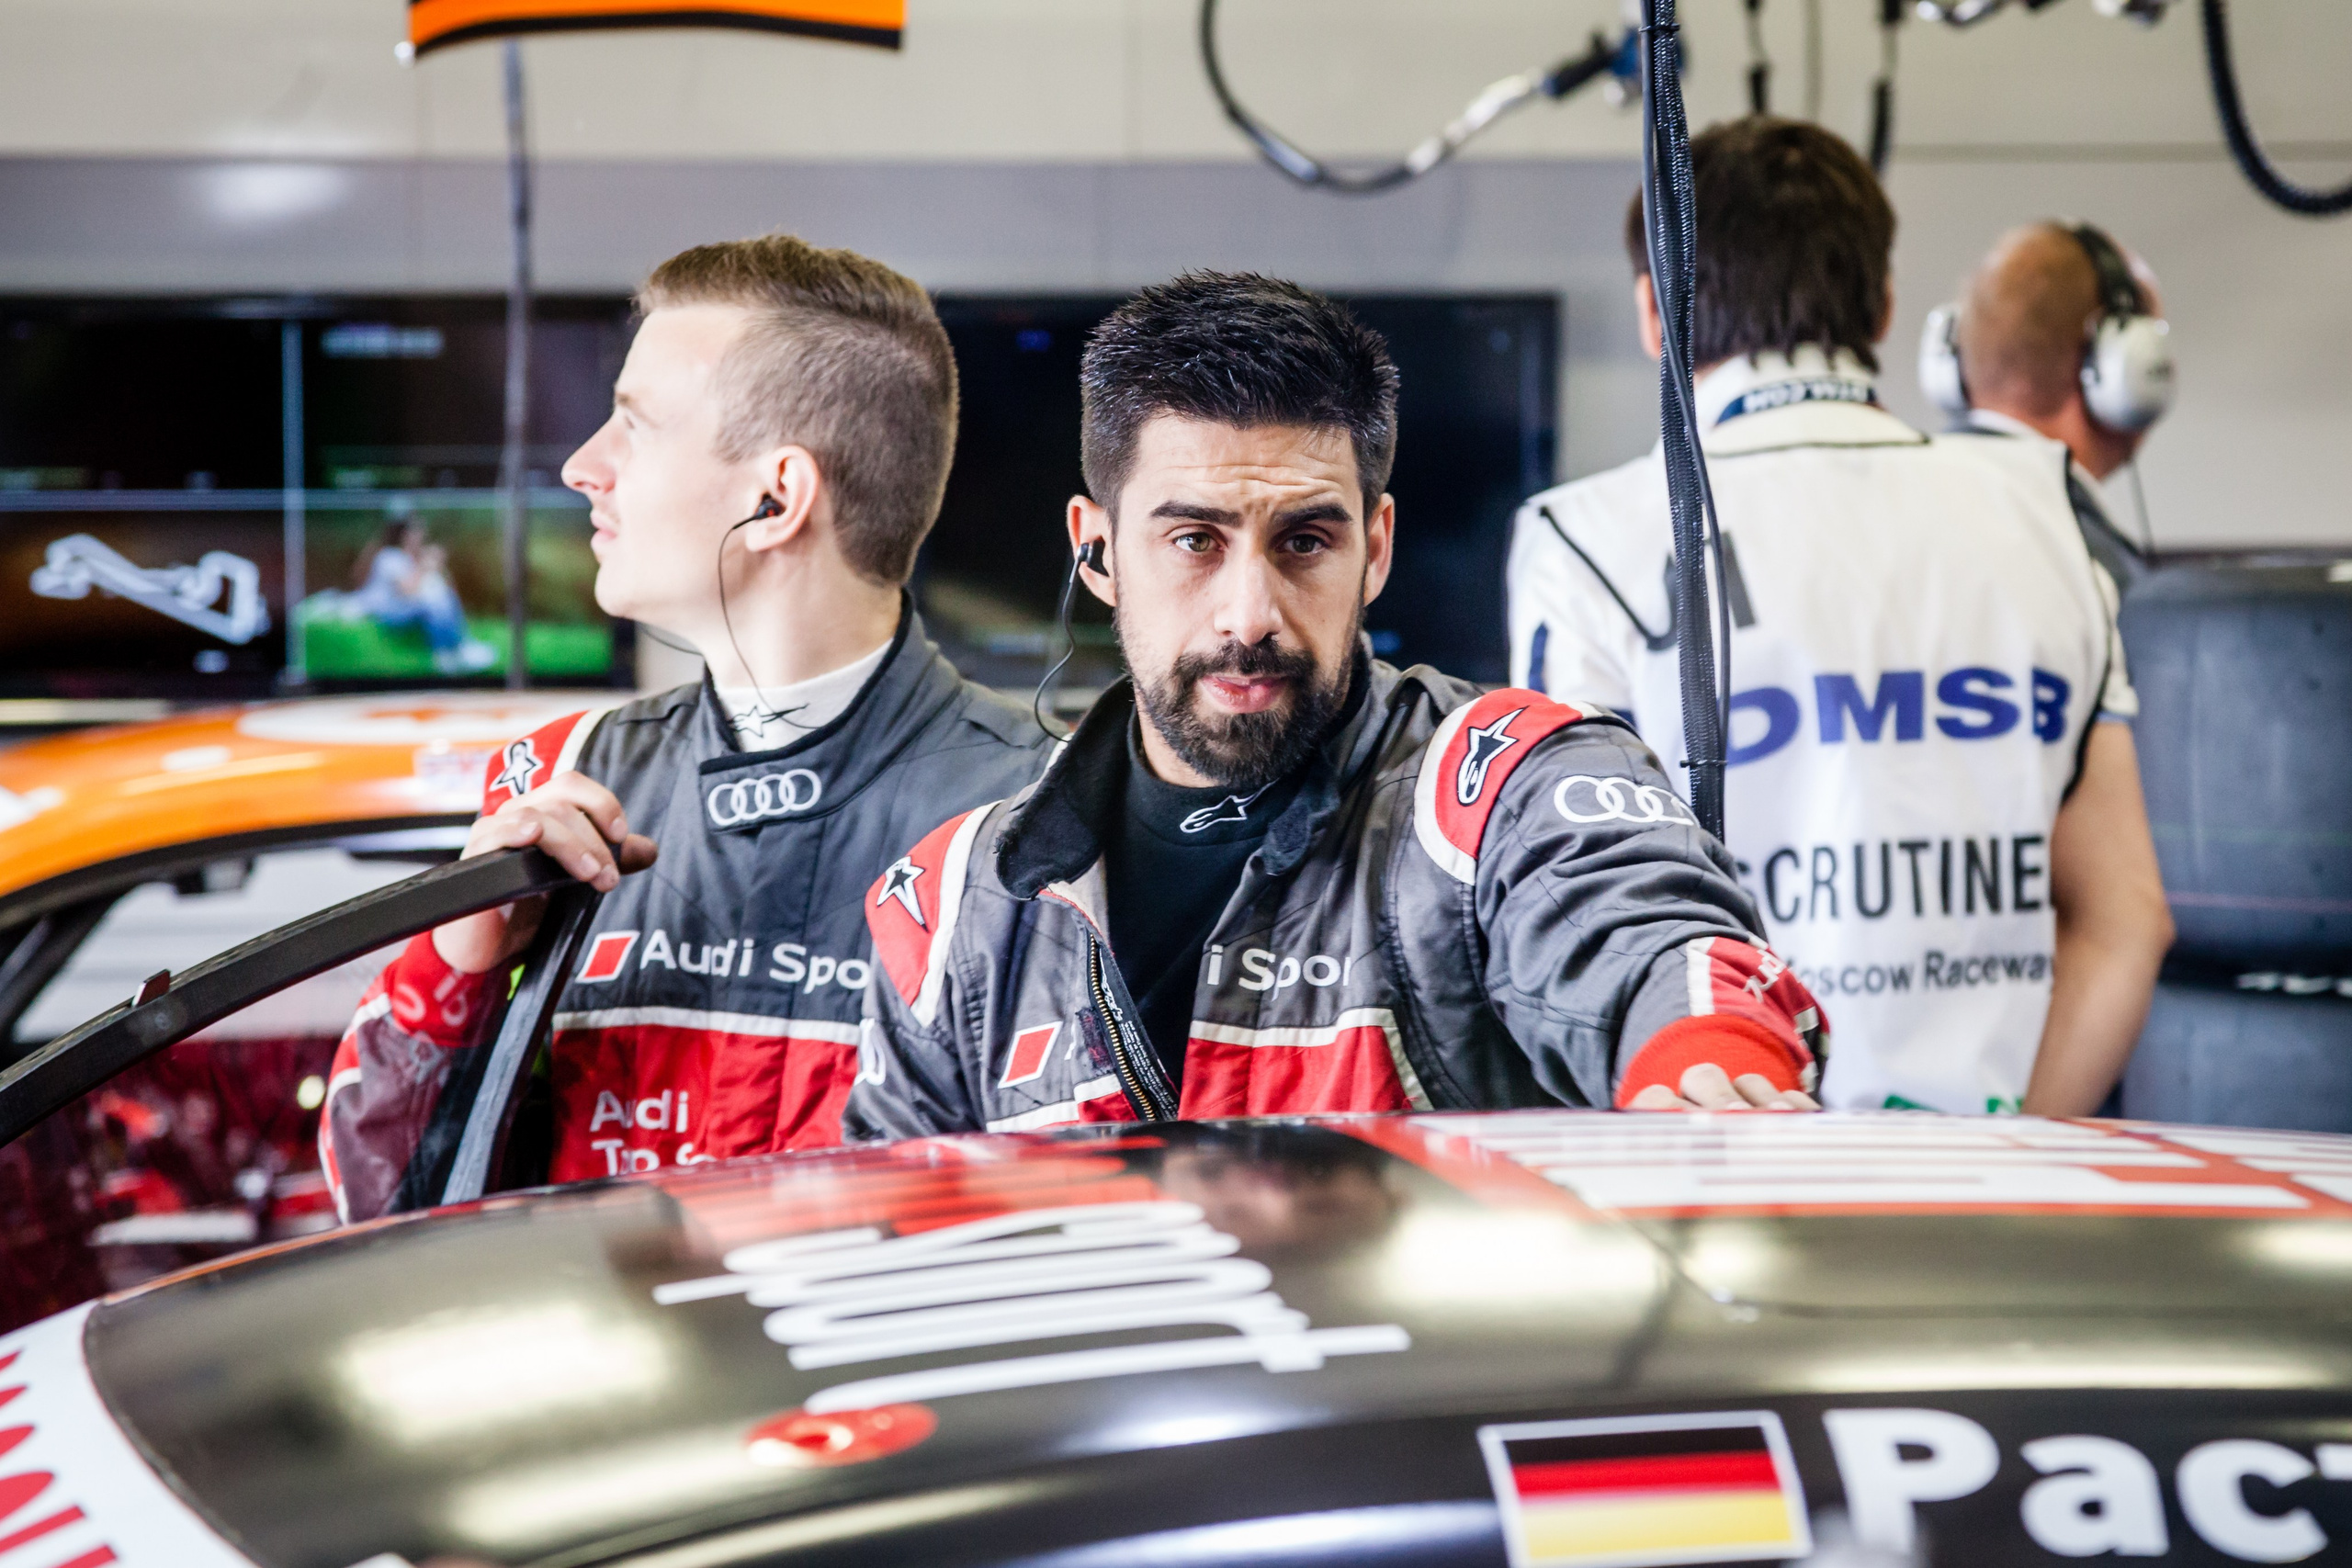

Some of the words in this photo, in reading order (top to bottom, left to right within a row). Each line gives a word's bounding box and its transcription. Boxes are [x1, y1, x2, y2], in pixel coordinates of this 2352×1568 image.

[1737, 835, 2044, 923] CRUTINE
[639, 929, 754, 977] Audi
[1787, 956, 1914, 996] oscow
[1925, 950, 2054, 990] Racewa
